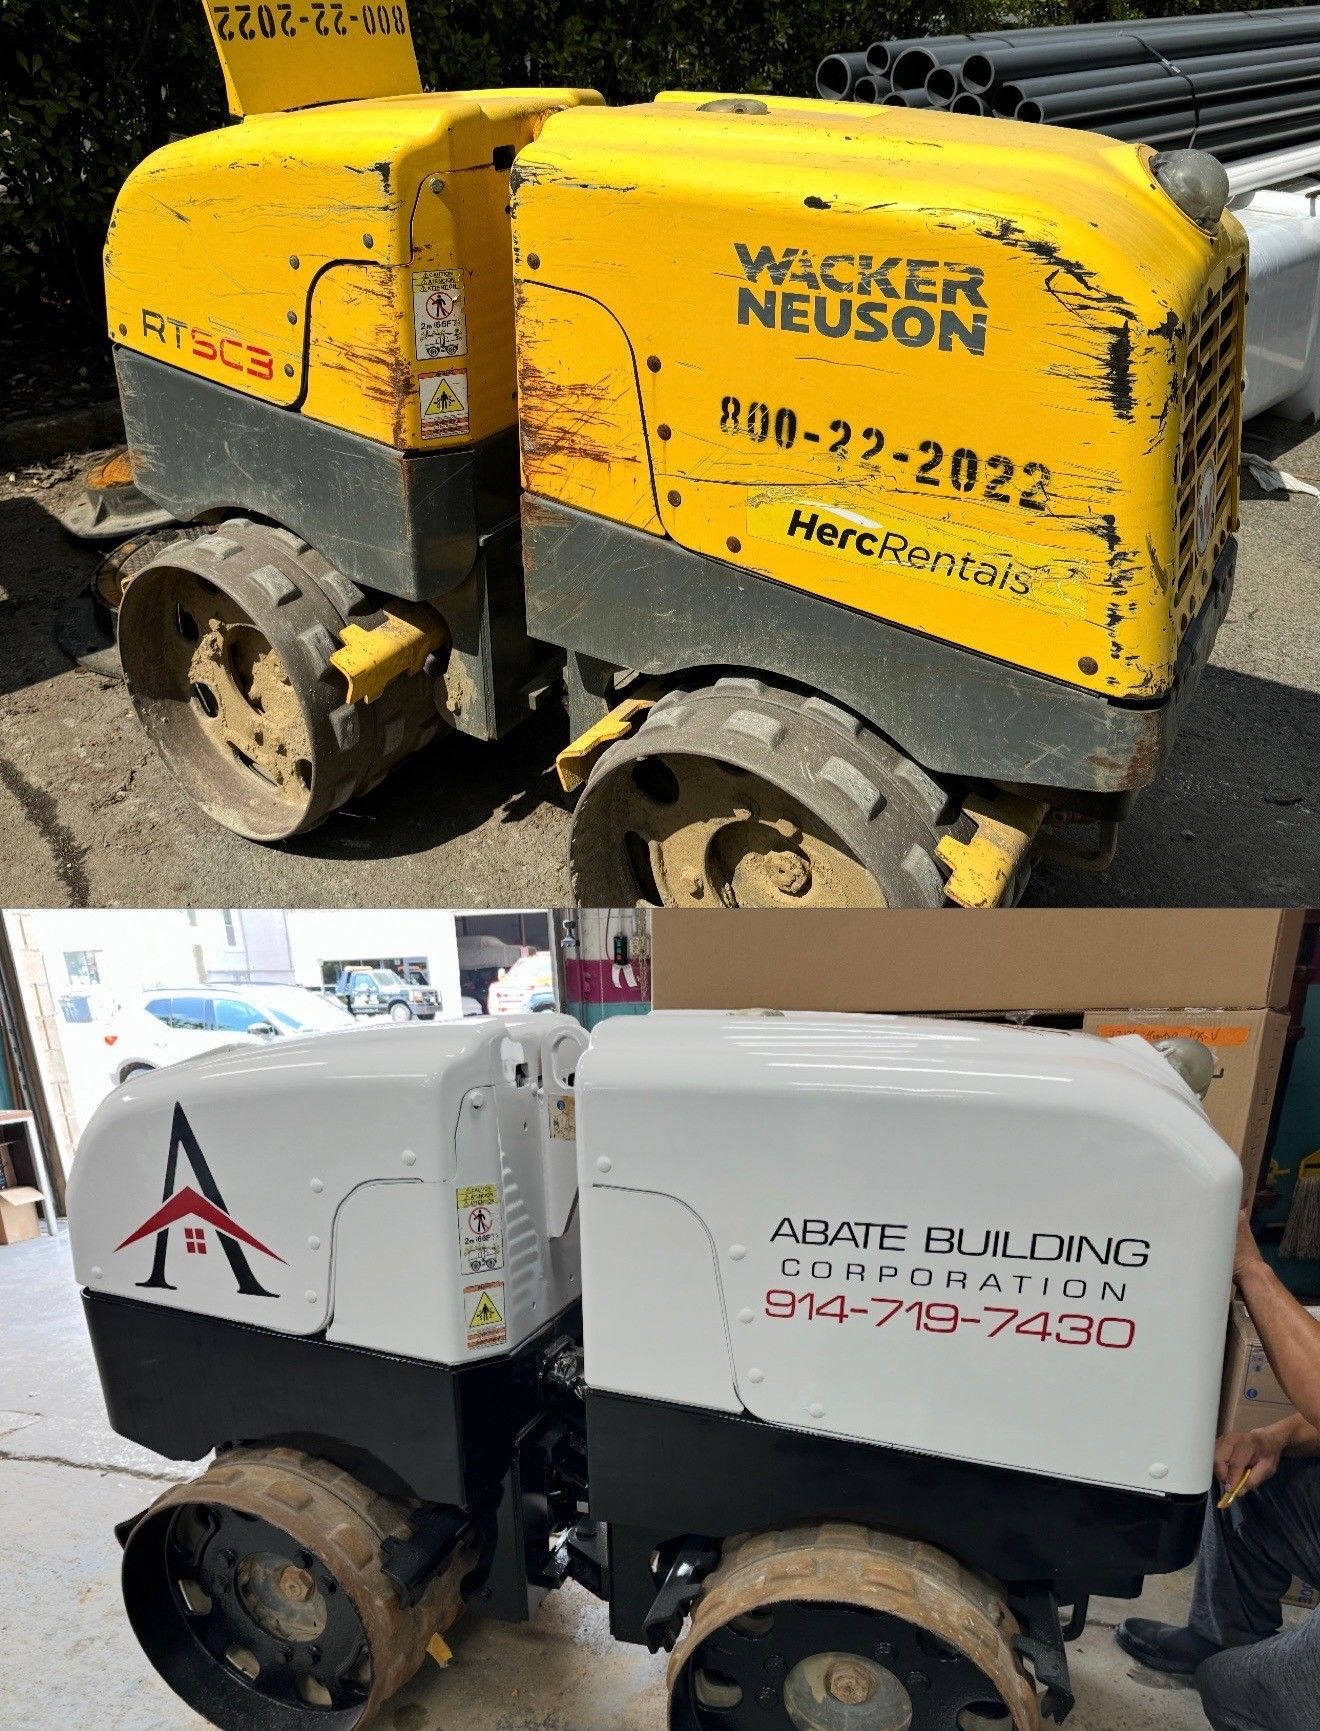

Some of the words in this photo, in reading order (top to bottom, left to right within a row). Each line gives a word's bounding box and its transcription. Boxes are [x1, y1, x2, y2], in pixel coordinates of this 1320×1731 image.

[213, 3, 406, 42] 800-22-2022
[734, 242, 989, 308] WACKER
[738, 287, 987, 356] NEUSON
[720, 396, 1052, 513] 800-22-2022
[770, 1217, 908, 1252] ABATE
[923, 1227, 1151, 1268] BUILDING
[780, 1258, 1127, 1301] CORPORATION
[765, 1289, 1136, 1349] 914-719-7430
